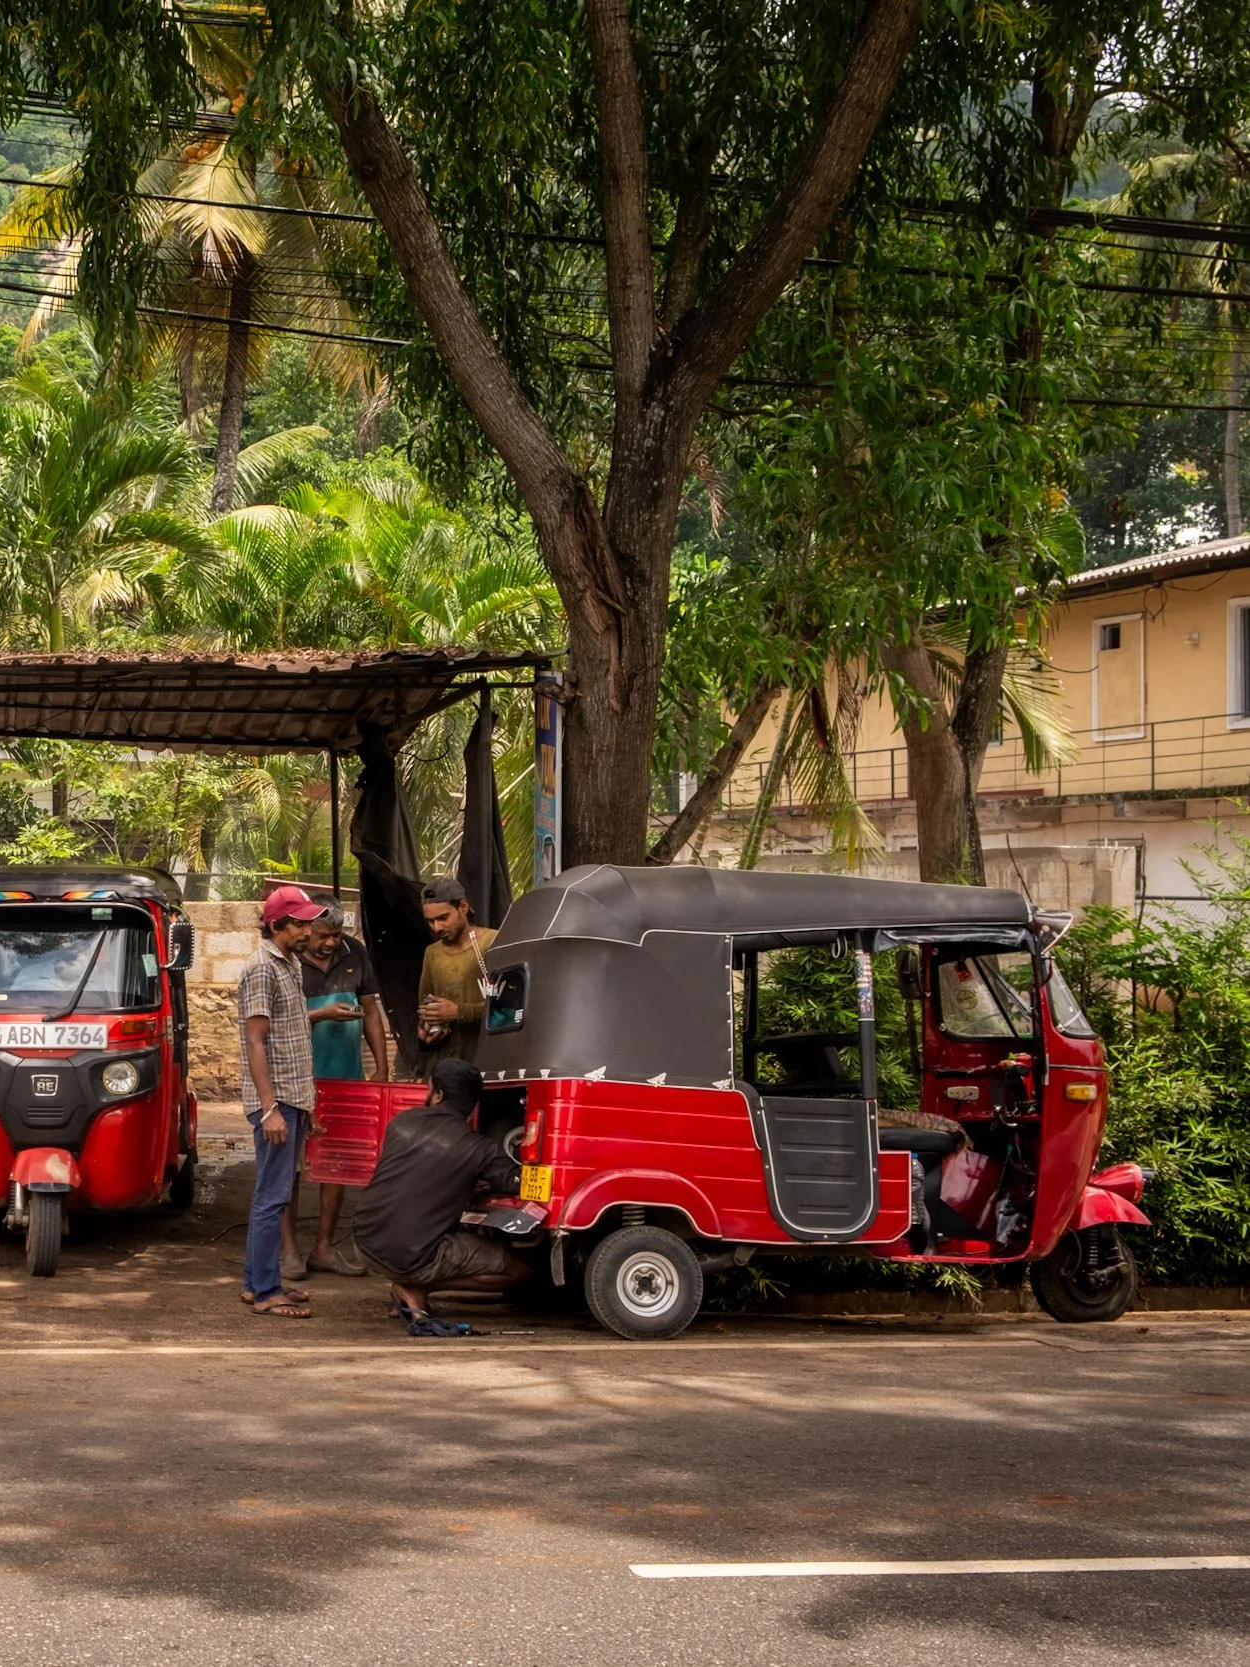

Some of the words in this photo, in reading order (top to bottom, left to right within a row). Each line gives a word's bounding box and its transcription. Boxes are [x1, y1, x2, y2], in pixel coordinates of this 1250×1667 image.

[7, 1026, 46, 1045] ABN
[54, 1026, 104, 1045] 7364
[36, 1081, 54, 1092] RE
